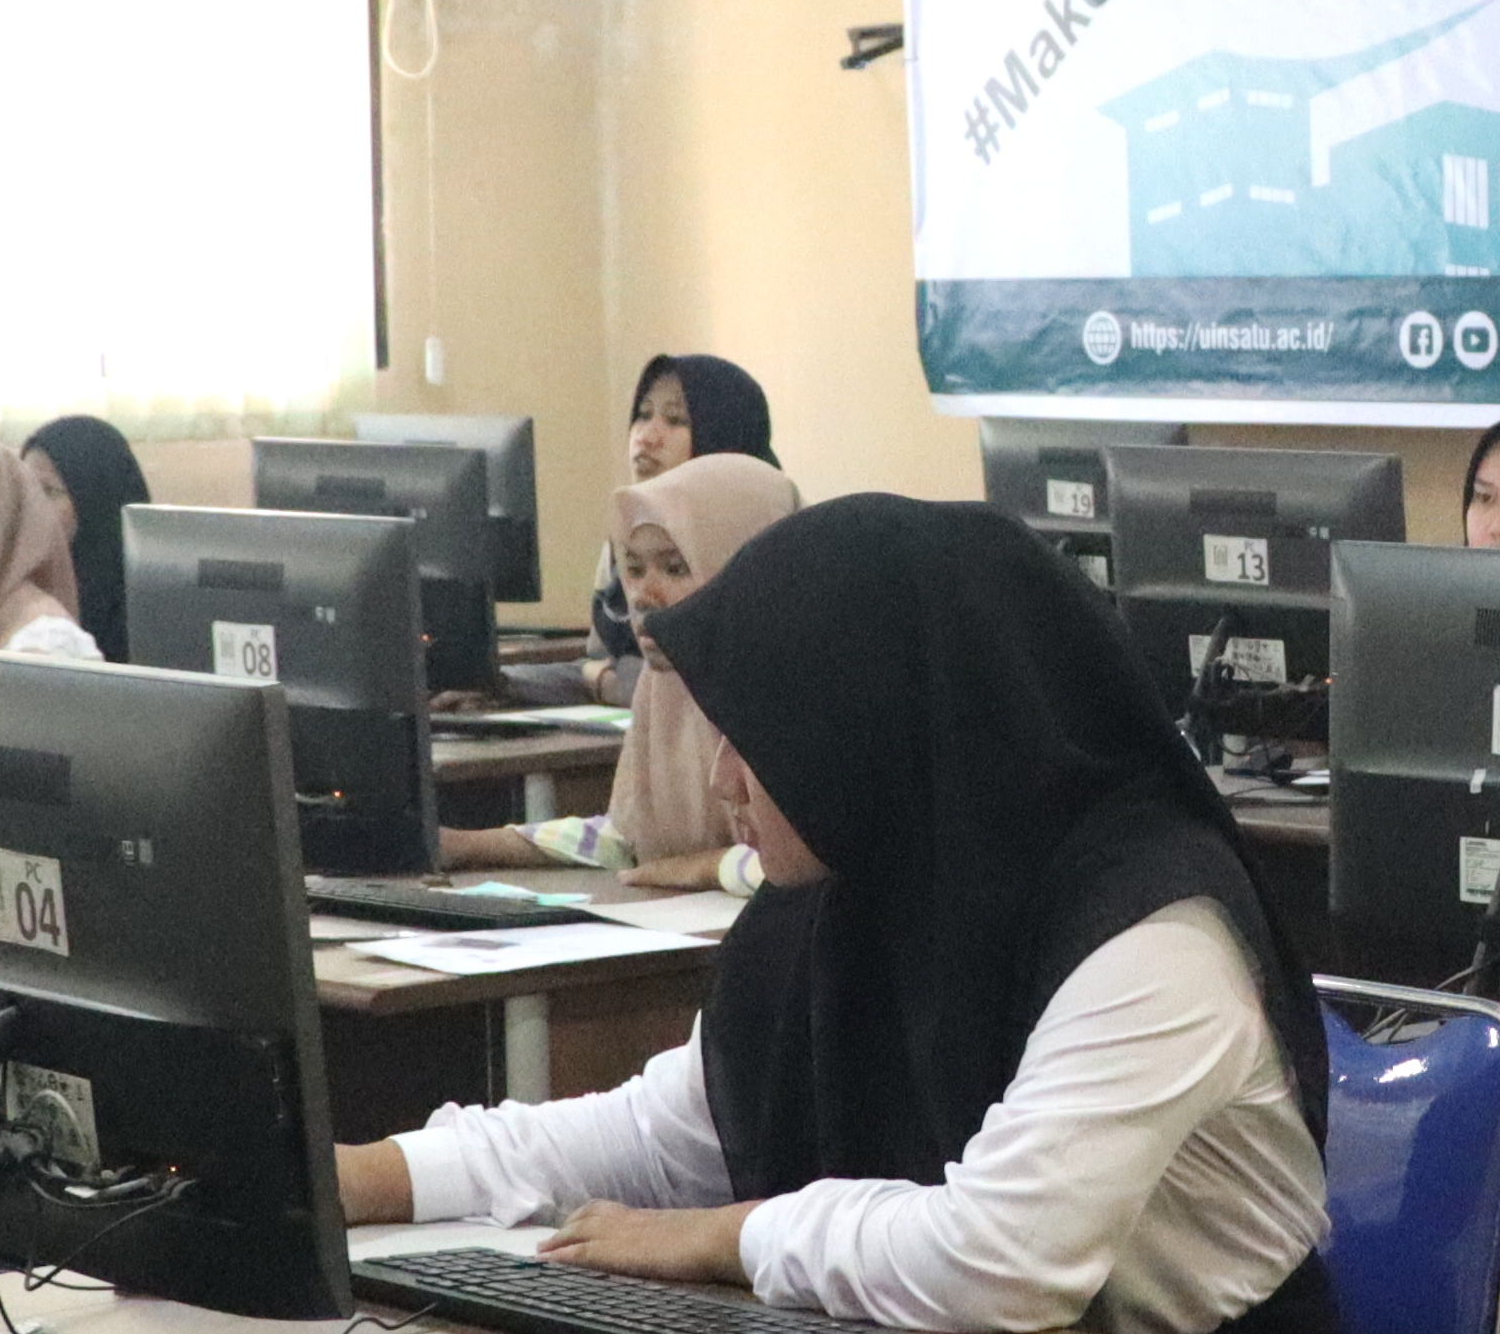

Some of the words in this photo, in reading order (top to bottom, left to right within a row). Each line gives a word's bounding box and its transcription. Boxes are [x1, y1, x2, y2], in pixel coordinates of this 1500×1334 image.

[1071, 493, 1091, 514] 19
[1237, 552, 1265, 581] 13
[243, 641, 272, 677] 08
[25, 860, 42, 883] PC
[15, 882, 61, 947] 04
